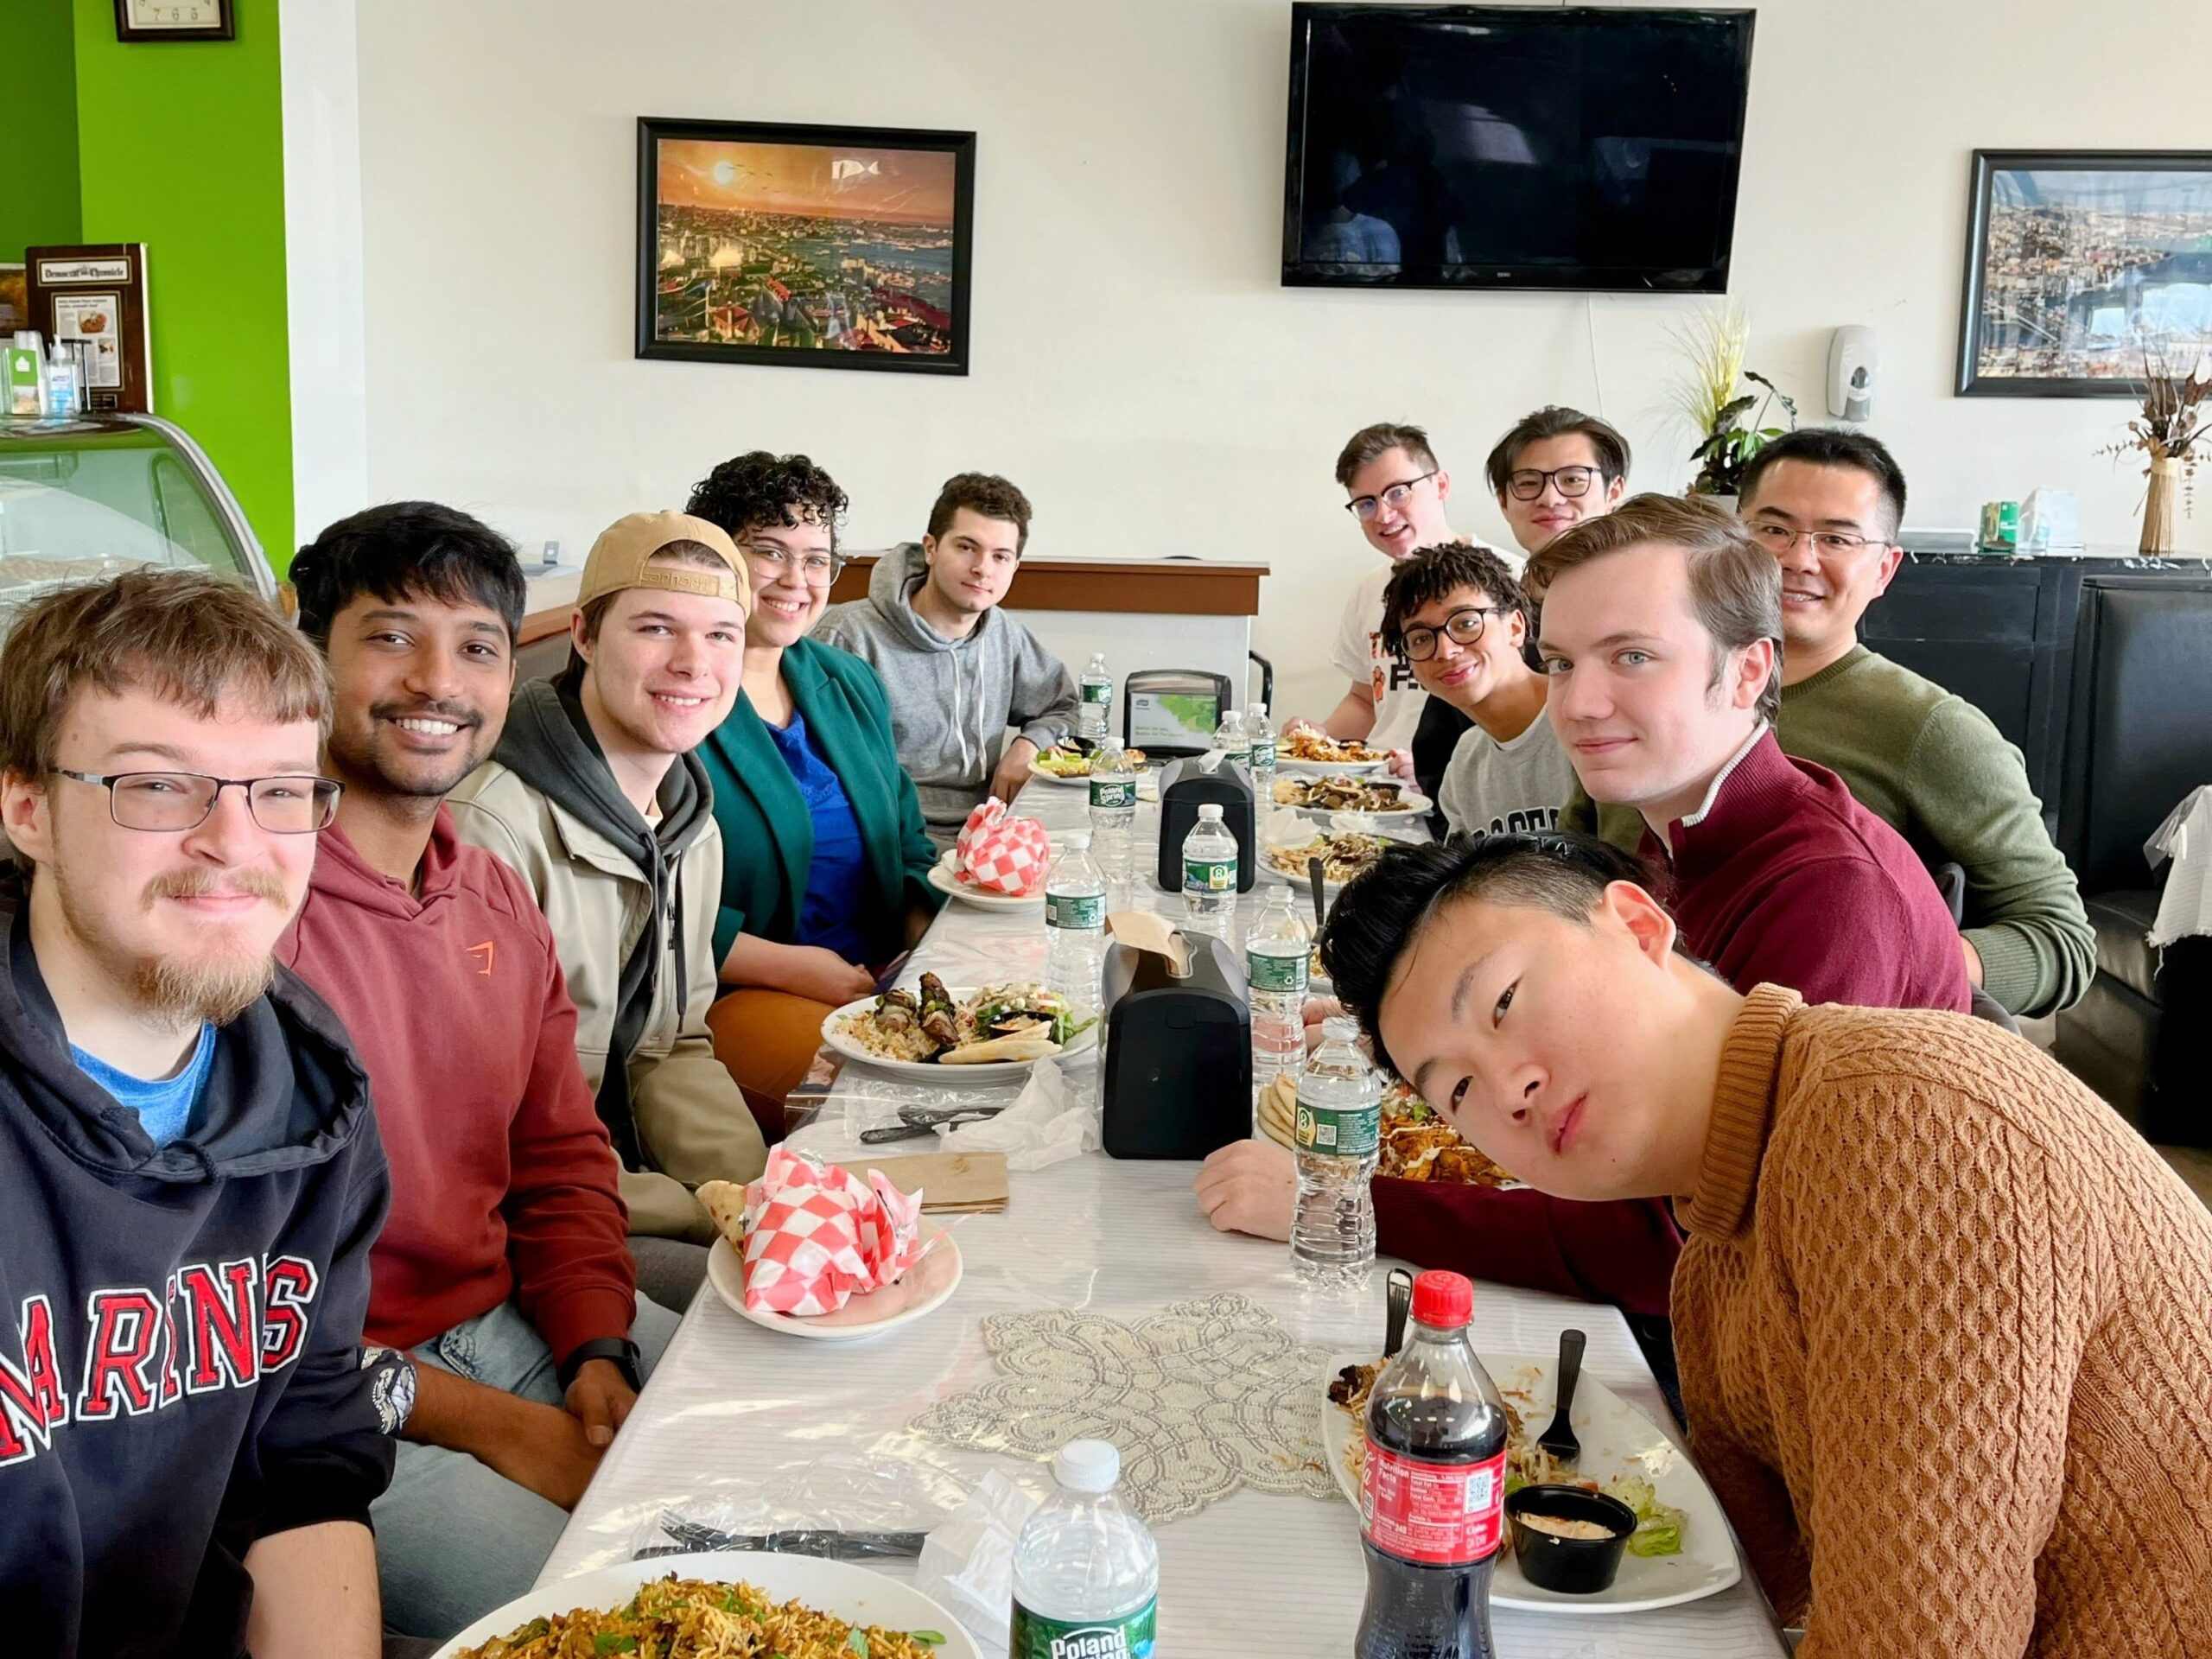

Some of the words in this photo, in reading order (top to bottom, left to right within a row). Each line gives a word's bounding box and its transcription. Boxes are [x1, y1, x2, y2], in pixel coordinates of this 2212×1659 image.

[153, 8, 160, 21] 7
[172, 7, 180, 21] 6
[1379, 1458, 1409, 1478] Nutrition
[1050, 1624, 1127, 1659] Poland
